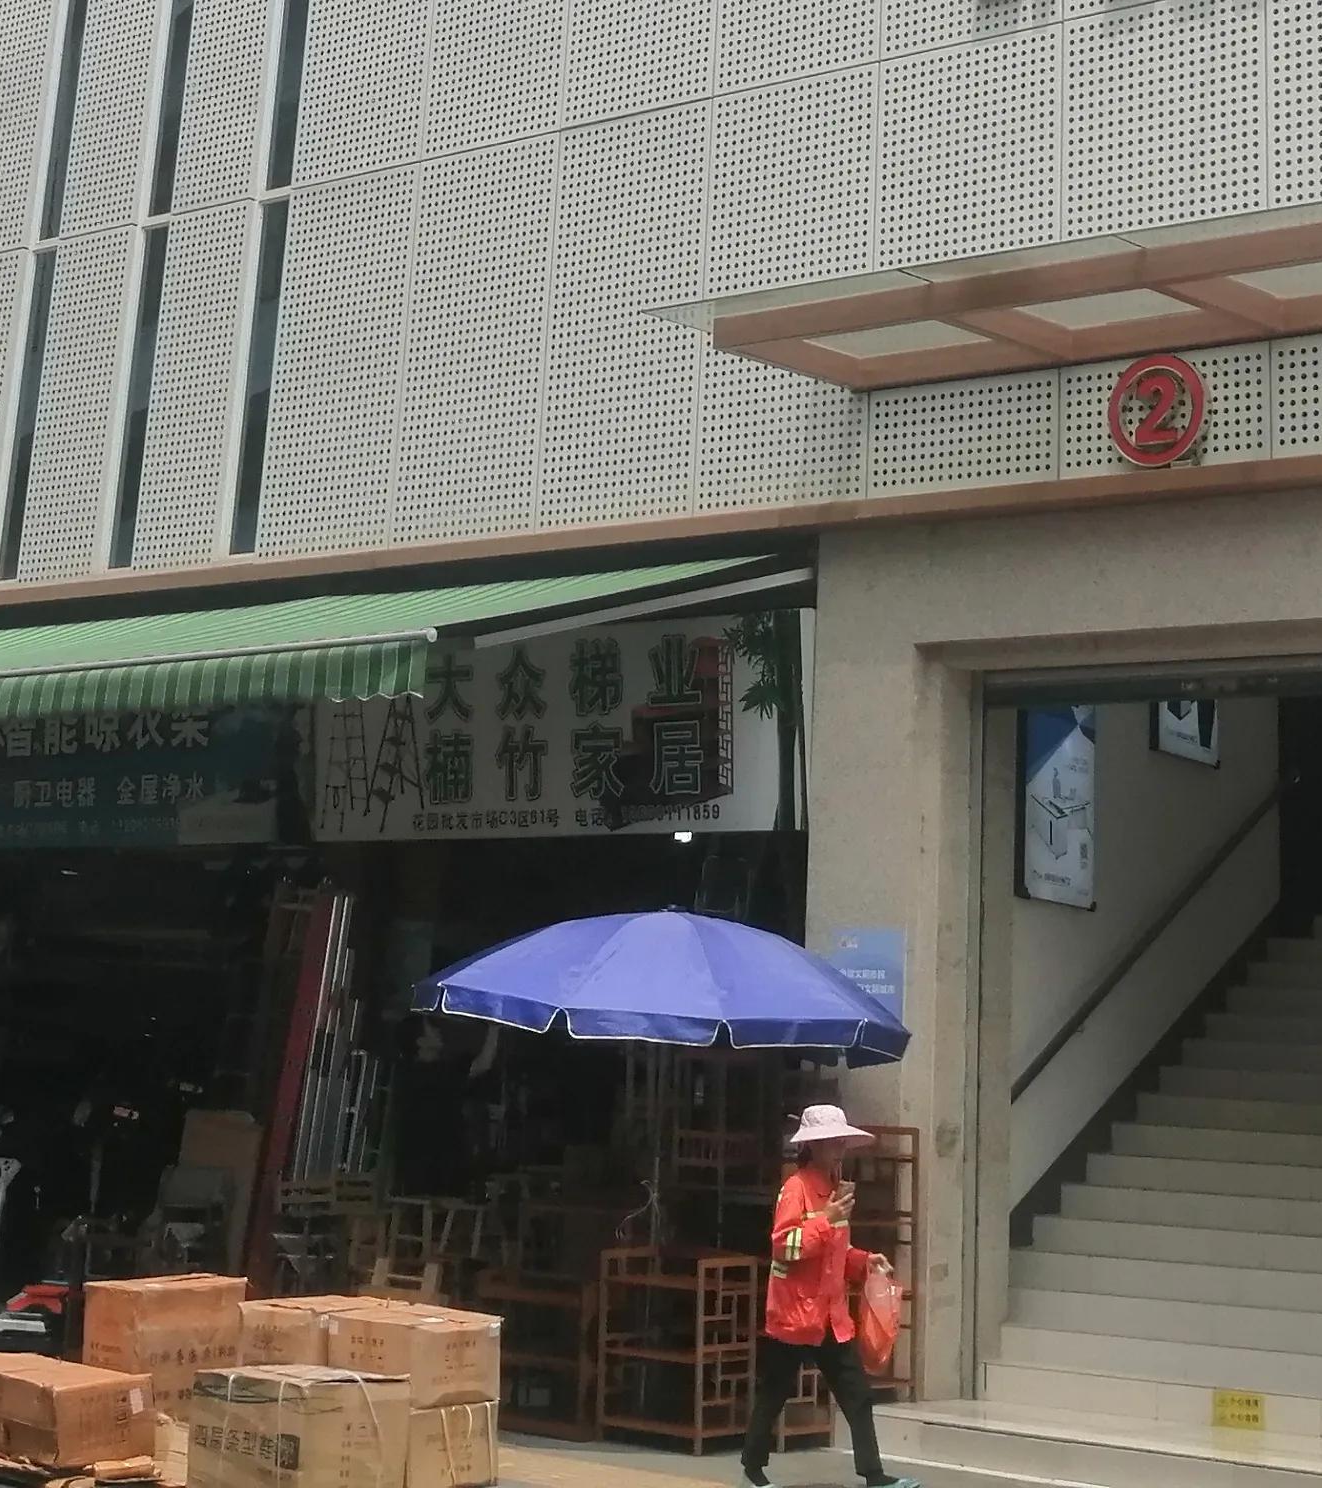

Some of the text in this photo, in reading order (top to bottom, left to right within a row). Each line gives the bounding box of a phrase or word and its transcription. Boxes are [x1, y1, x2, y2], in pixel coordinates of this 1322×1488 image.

[423, 633, 705, 724] 大众梯业
[13, 776, 97, 809] 厨卫电器
[423, 718, 705, 806] 楠竹家居
